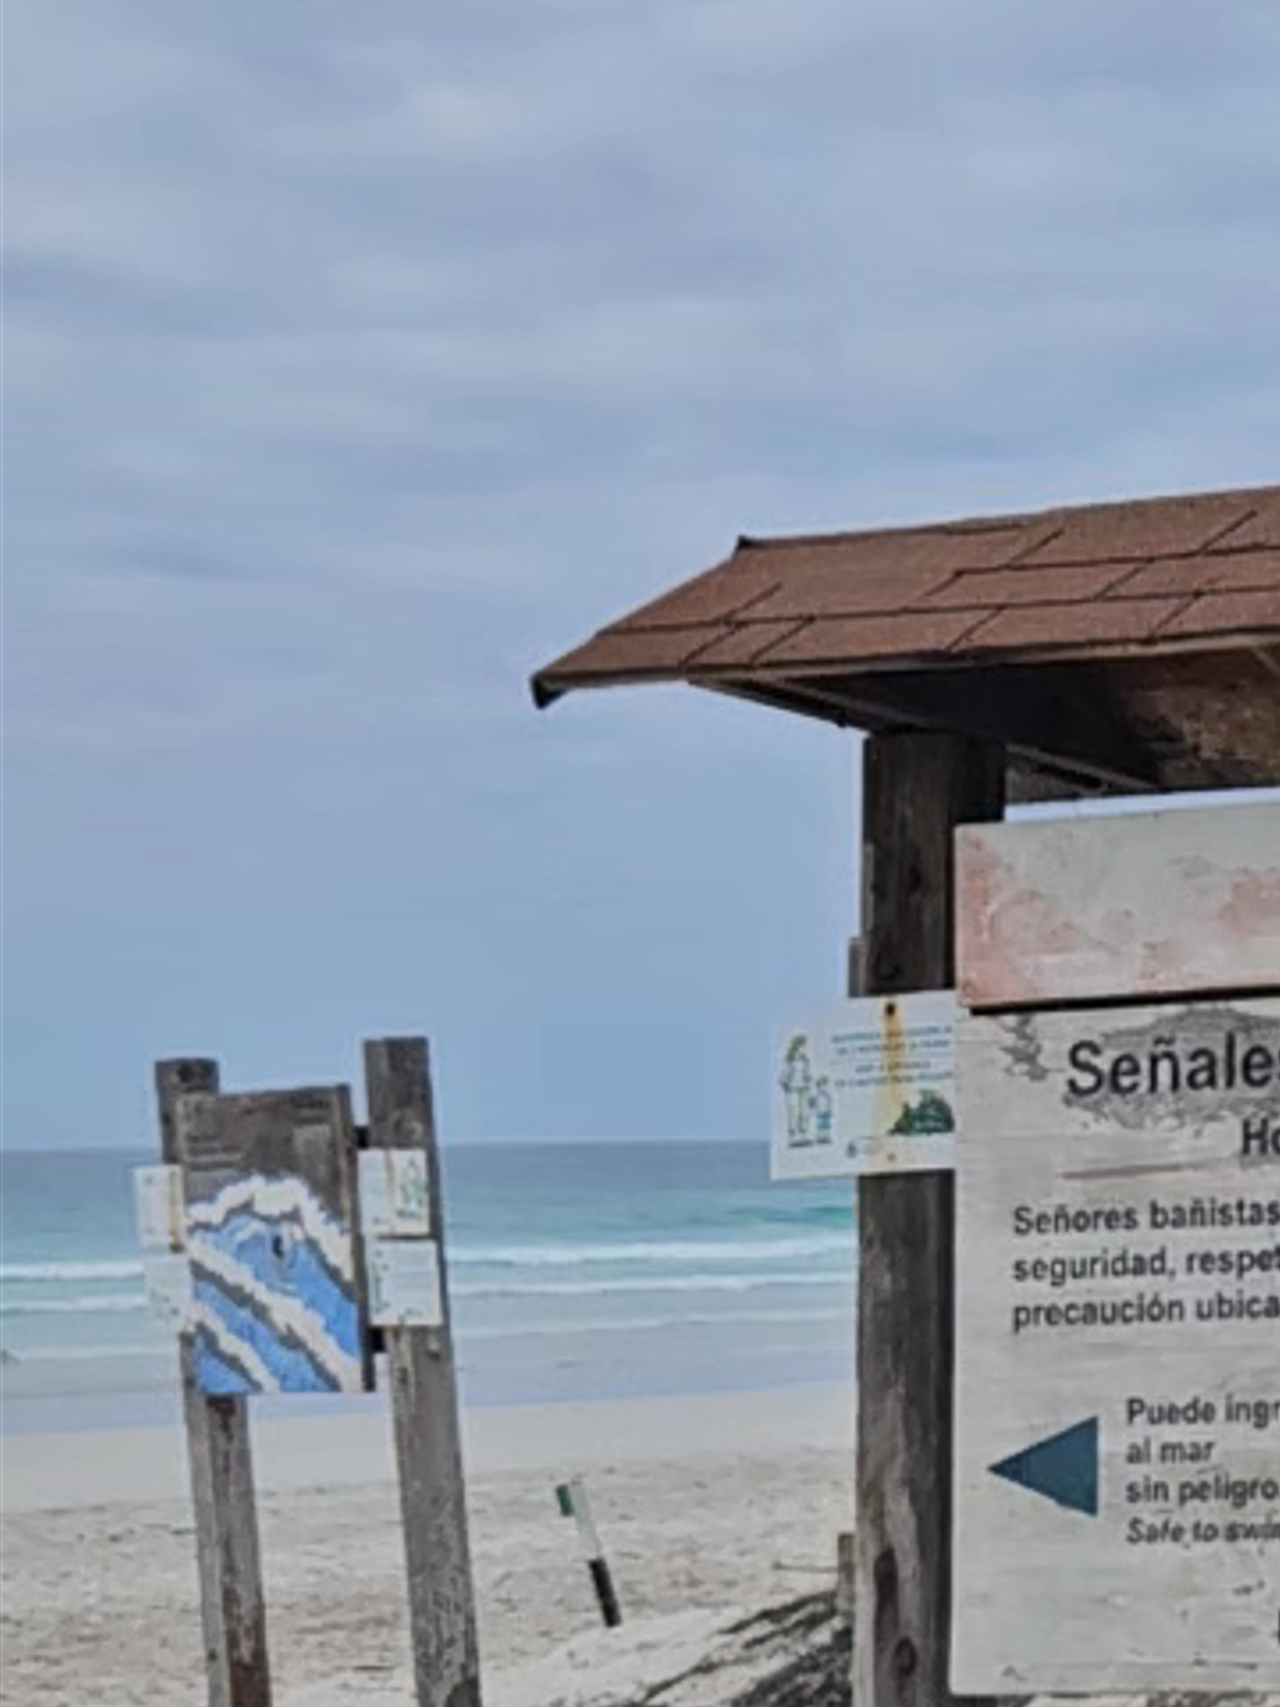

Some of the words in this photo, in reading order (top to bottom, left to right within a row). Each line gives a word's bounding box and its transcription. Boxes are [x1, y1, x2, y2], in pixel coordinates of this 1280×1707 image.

[1013, 1205, 1138, 1235] Señores
[1013, 1246, 1175, 1287] seguridad,
[1013, 1295, 1184, 1332] precaución
[1126, 1396, 1216, 1426] Puede
[1126, 1437, 1150, 1464] al
[1160, 1441, 1215, 1464] mar
[1126, 1475, 1169, 1503] sin
[1126, 1517, 1184, 1544] Safe
[1193, 1522, 1219, 1542] to
